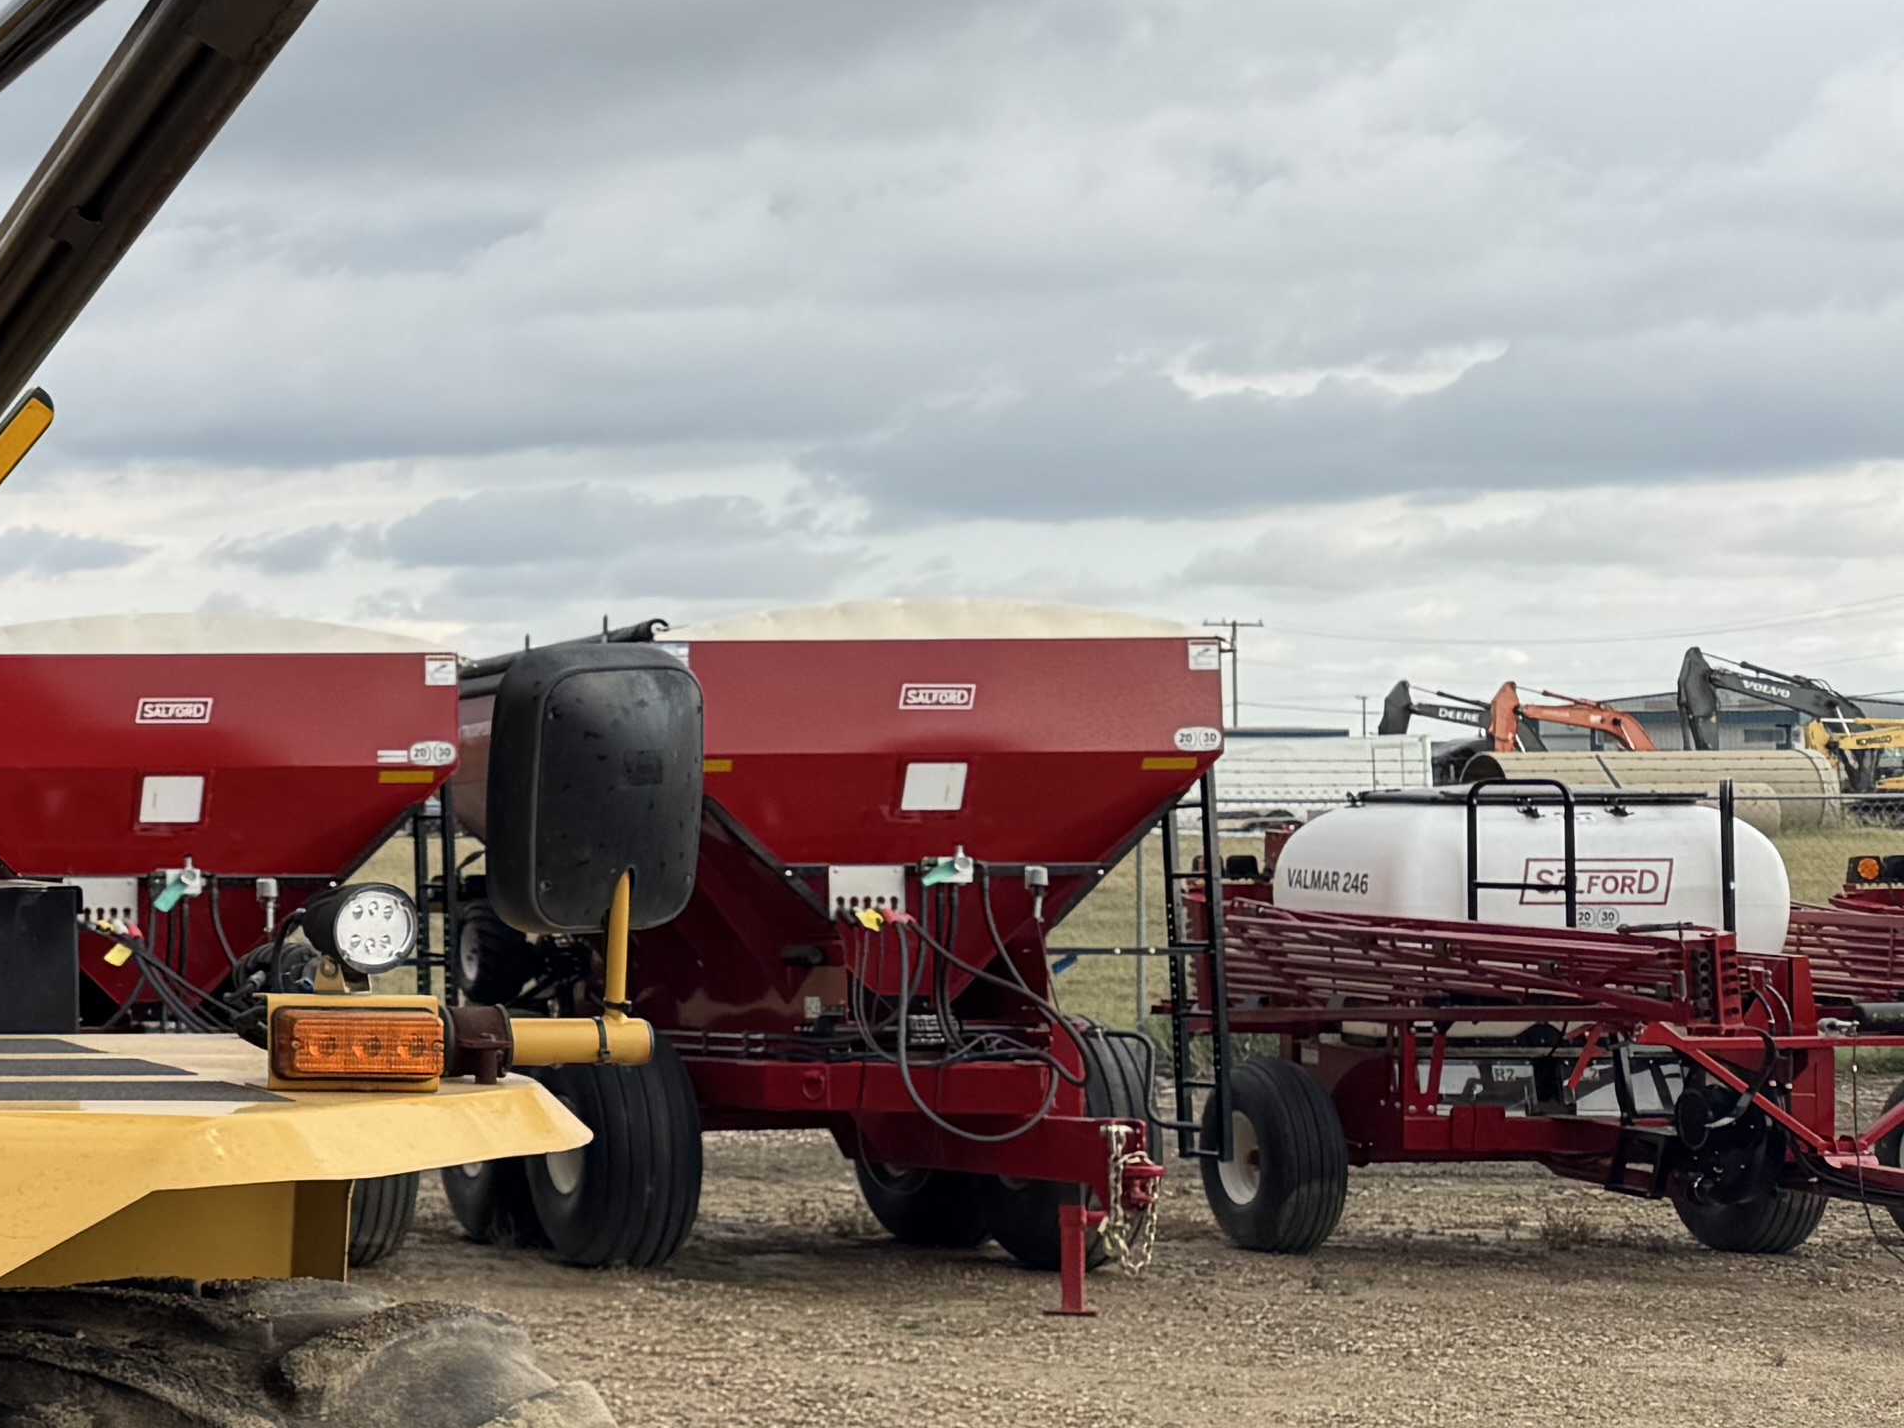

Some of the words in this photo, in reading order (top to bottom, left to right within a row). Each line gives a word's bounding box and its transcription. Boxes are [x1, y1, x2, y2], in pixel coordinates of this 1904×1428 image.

[906, 689, 969, 704] SALFORD
[1742, 679, 1791, 699] VOLVO
[143, 703, 205, 718] SALFORD
[1438, 707, 1480, 723] DEERE
[1288, 868, 1340, 892] VALMAR
[1342, 871, 1369, 895] 246
